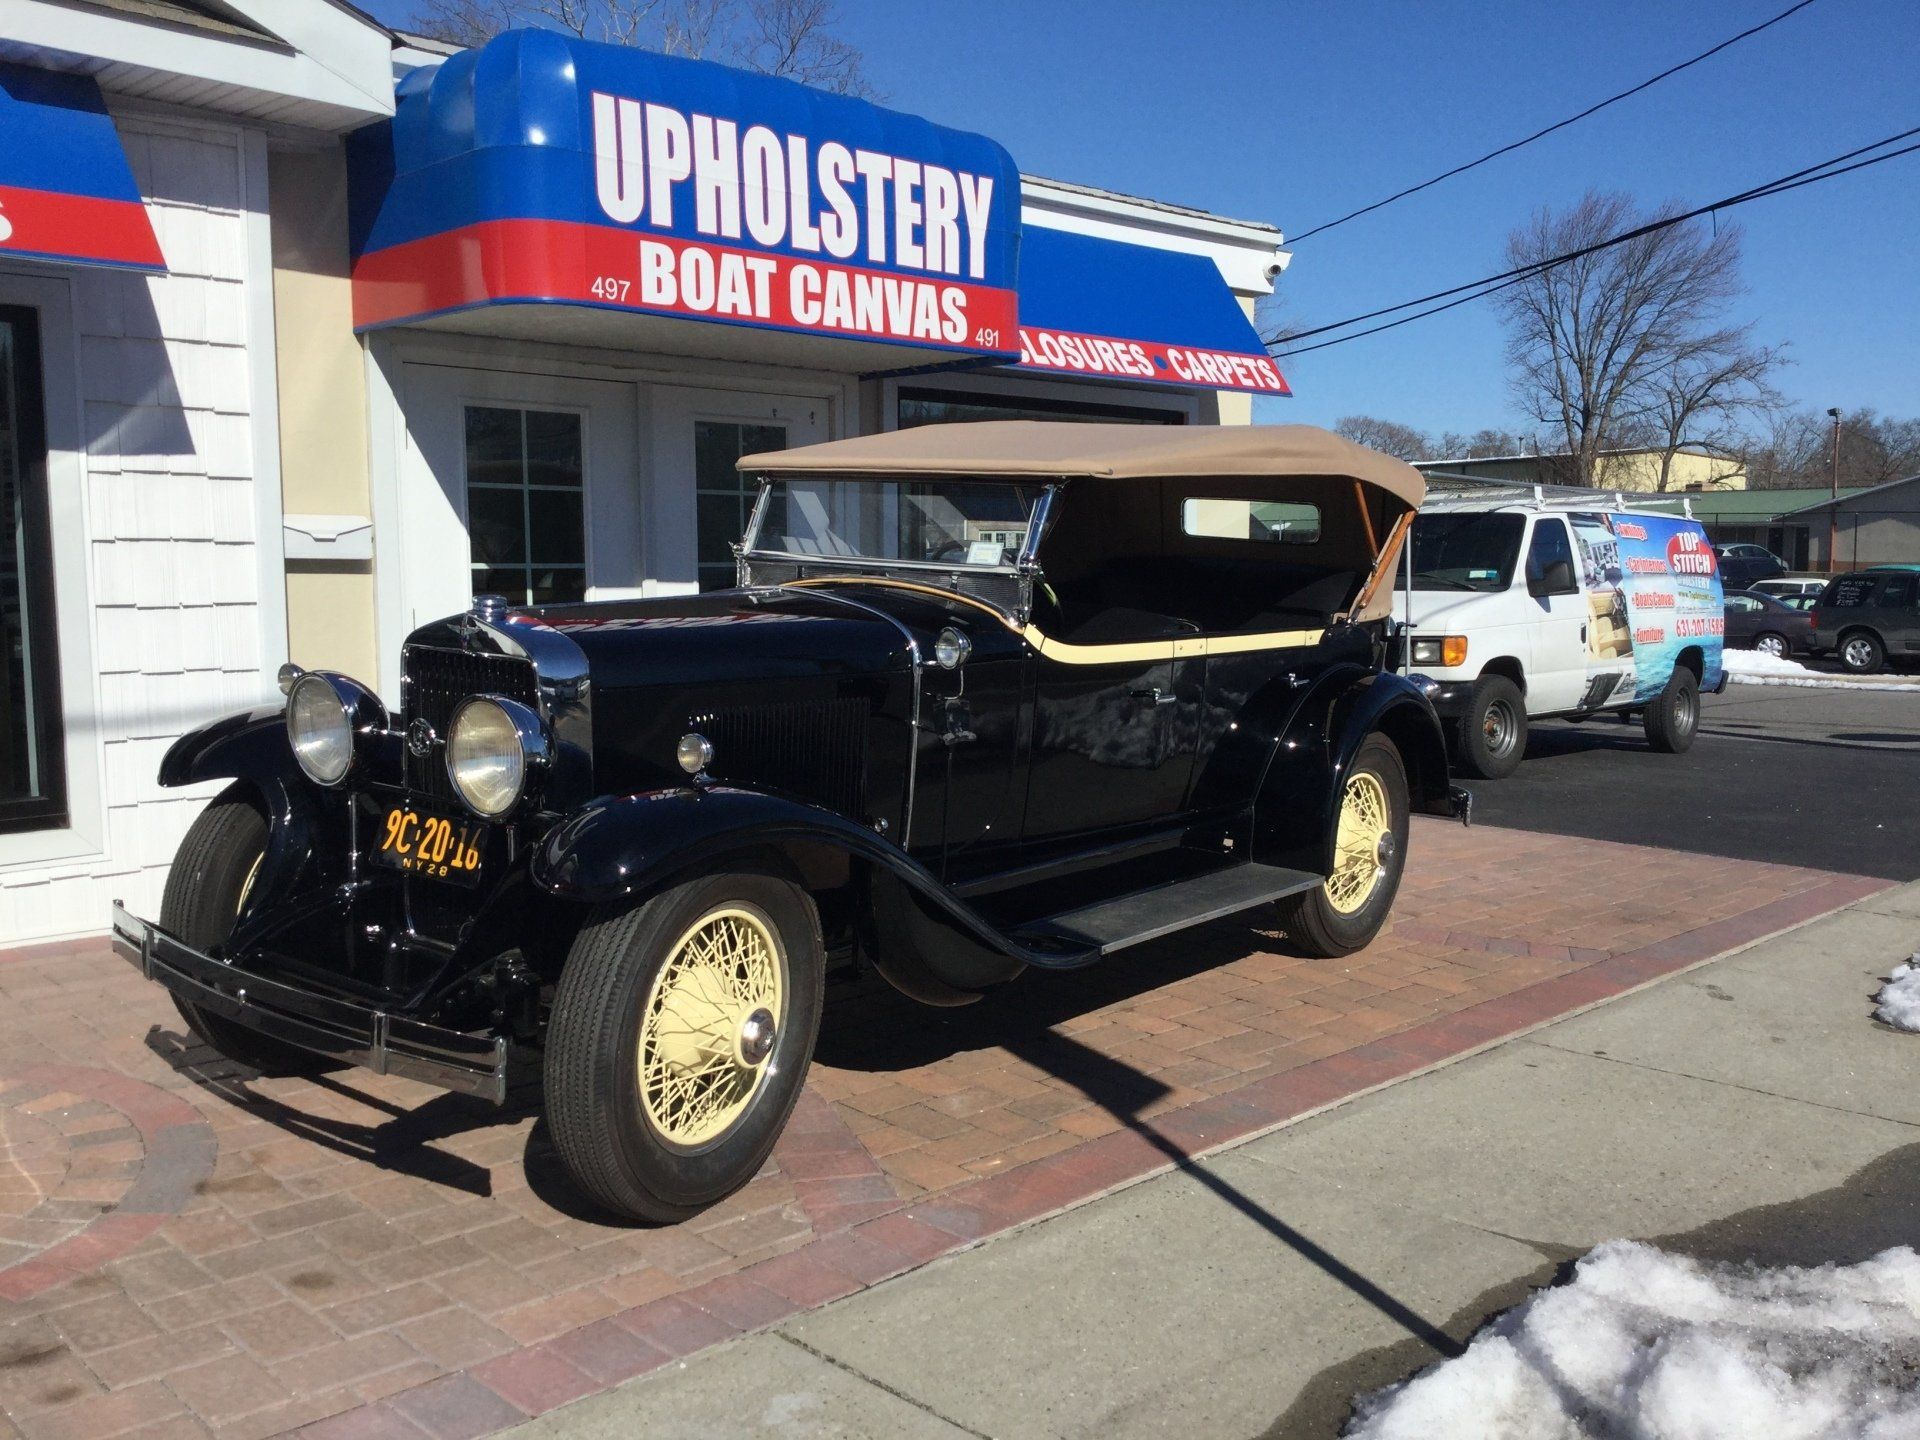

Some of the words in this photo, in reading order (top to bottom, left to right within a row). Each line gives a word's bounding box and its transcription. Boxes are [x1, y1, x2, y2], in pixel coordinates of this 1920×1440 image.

[592, 91, 994, 279] UPHOLSTERY
[591, 276, 631, 302] 497
[640, 240, 777, 319] BOAT
[789, 264, 968, 343] CANVAS
[975, 327, 1000, 348] 491
[1167, 348, 1281, 390] CARPETS
[1676, 532, 1699, 552] TOP
[1672, 553, 1711, 574] STITCH
